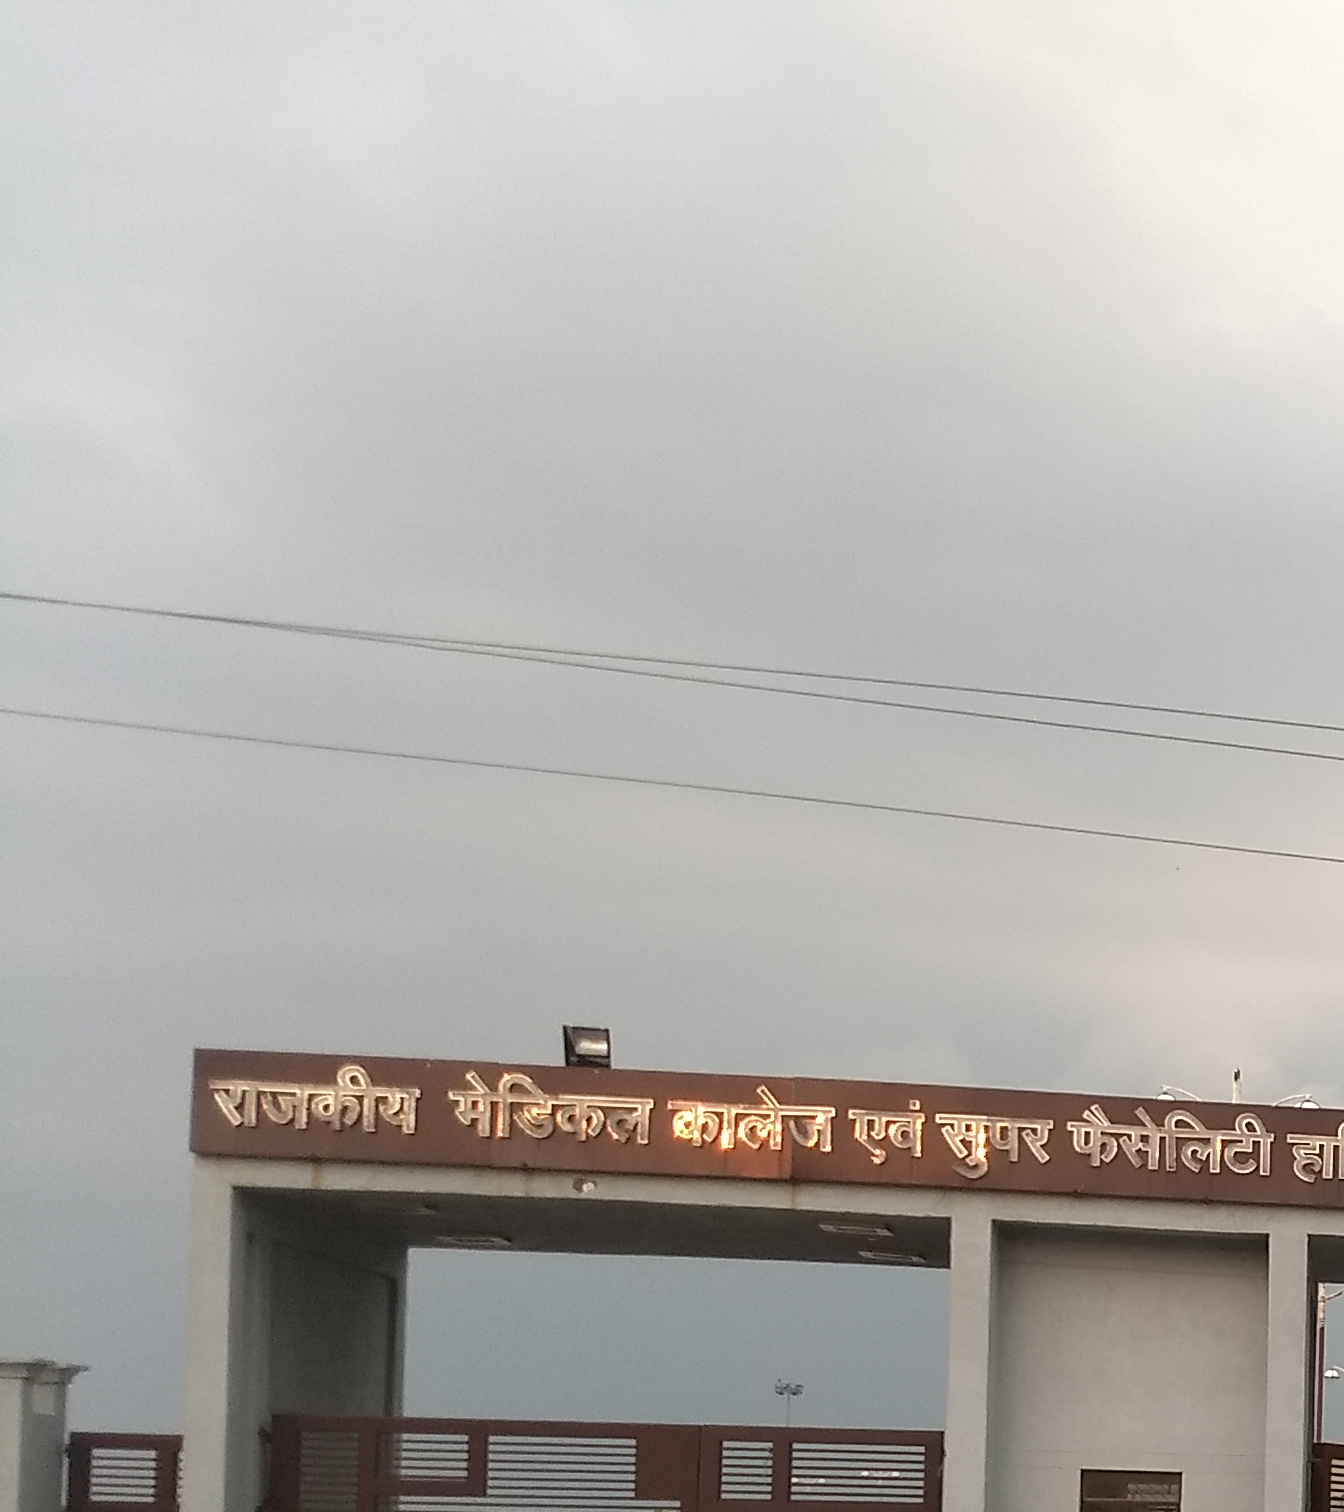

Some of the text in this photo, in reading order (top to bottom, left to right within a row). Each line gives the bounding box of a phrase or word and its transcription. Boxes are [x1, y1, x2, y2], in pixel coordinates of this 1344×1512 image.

[208, 1064, 421, 1135] राजकीय
[447, 1069, 656, 1146] मेडिकल
[667, 1085, 836, 1153] कालेज
[848, 1099, 927, 1165] एवं
[936, 1113, 1053, 1180] सुपर
[1067, 1104, 1275, 1176] फैसेलिटी
